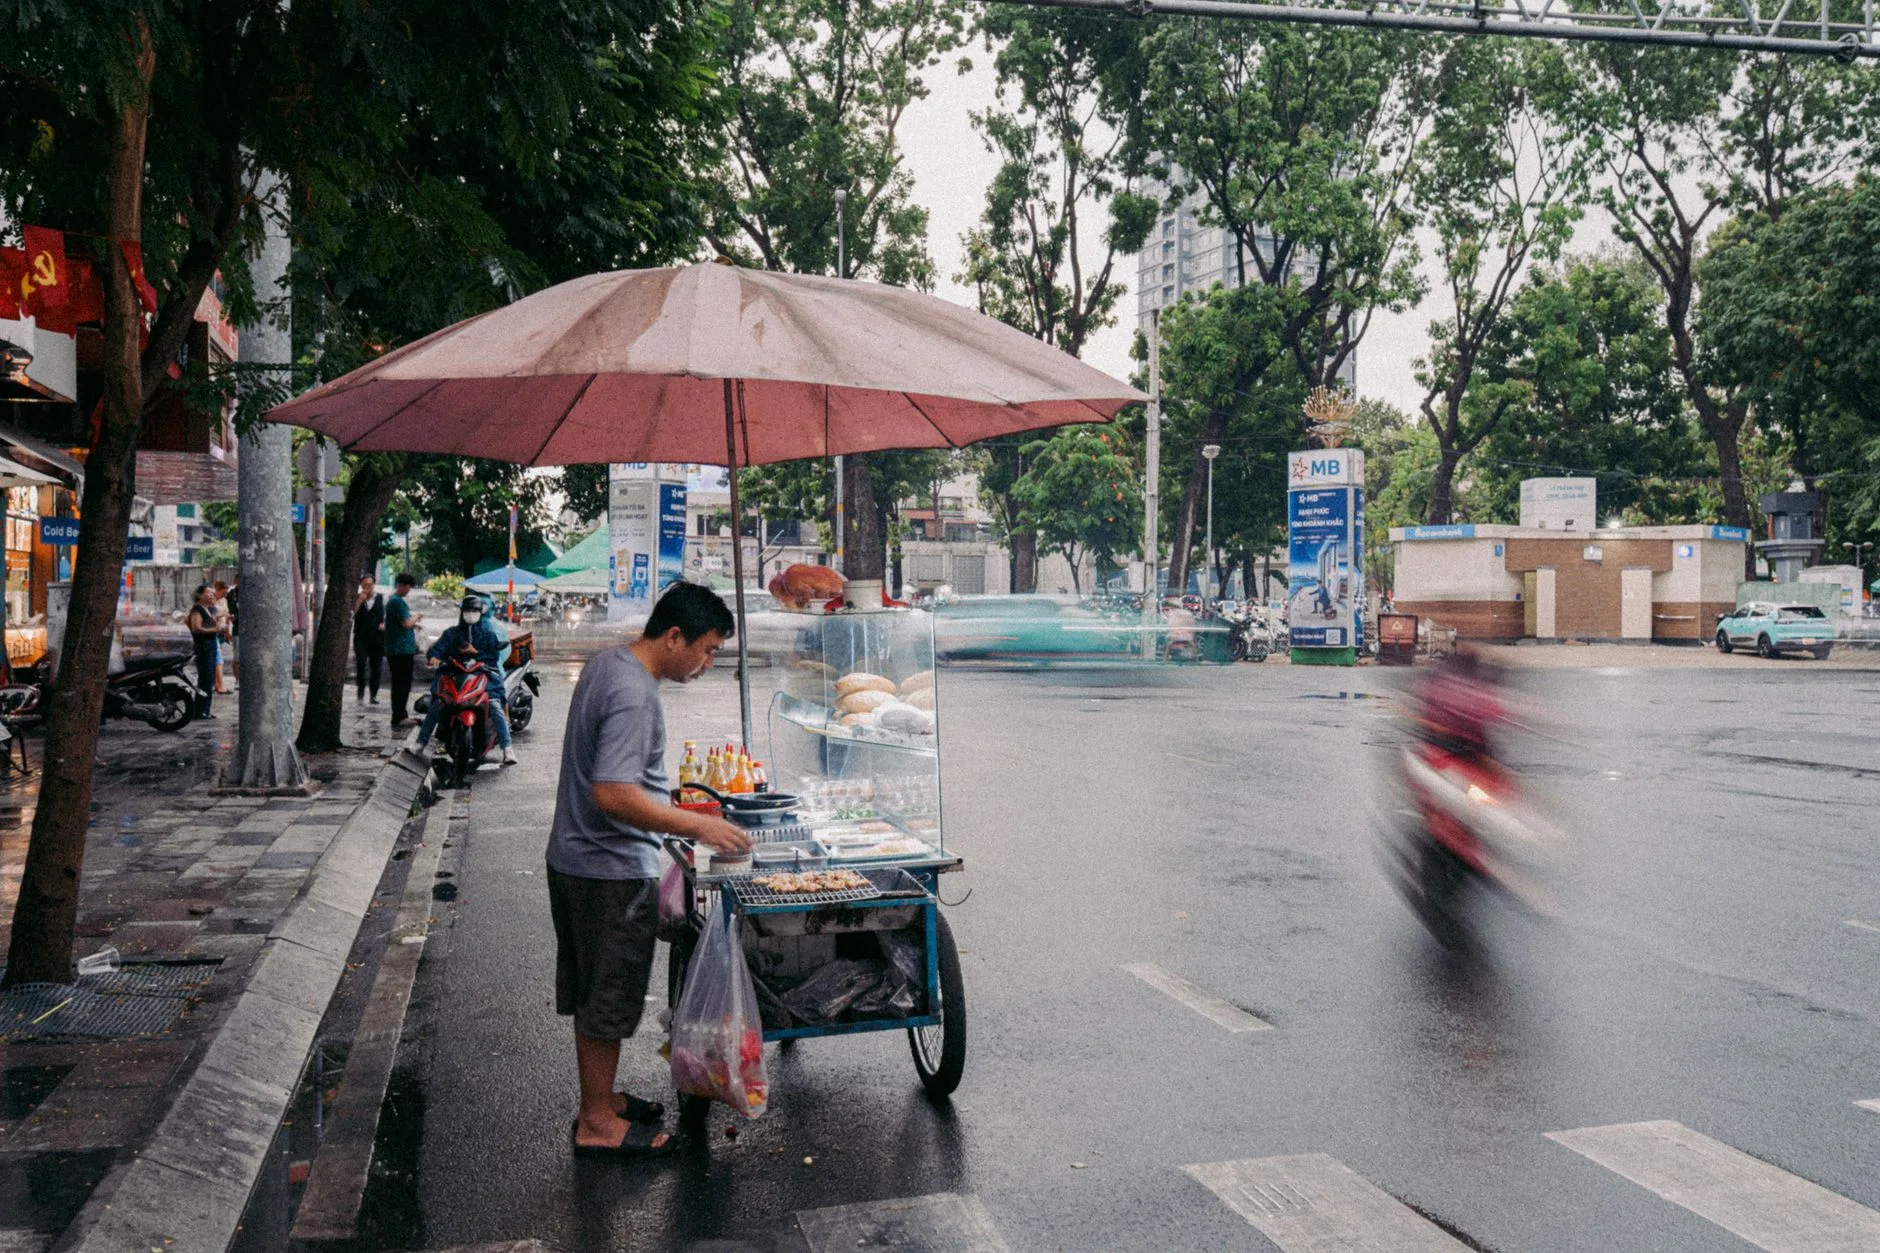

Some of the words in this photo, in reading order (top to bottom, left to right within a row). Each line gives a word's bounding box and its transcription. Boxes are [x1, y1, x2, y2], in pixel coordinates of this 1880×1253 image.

[1311, 459, 1341, 477] MB
[43, 525, 64, 537] Cold
[66, 526, 80, 537] Be
[133, 544, 150, 553] Beer
